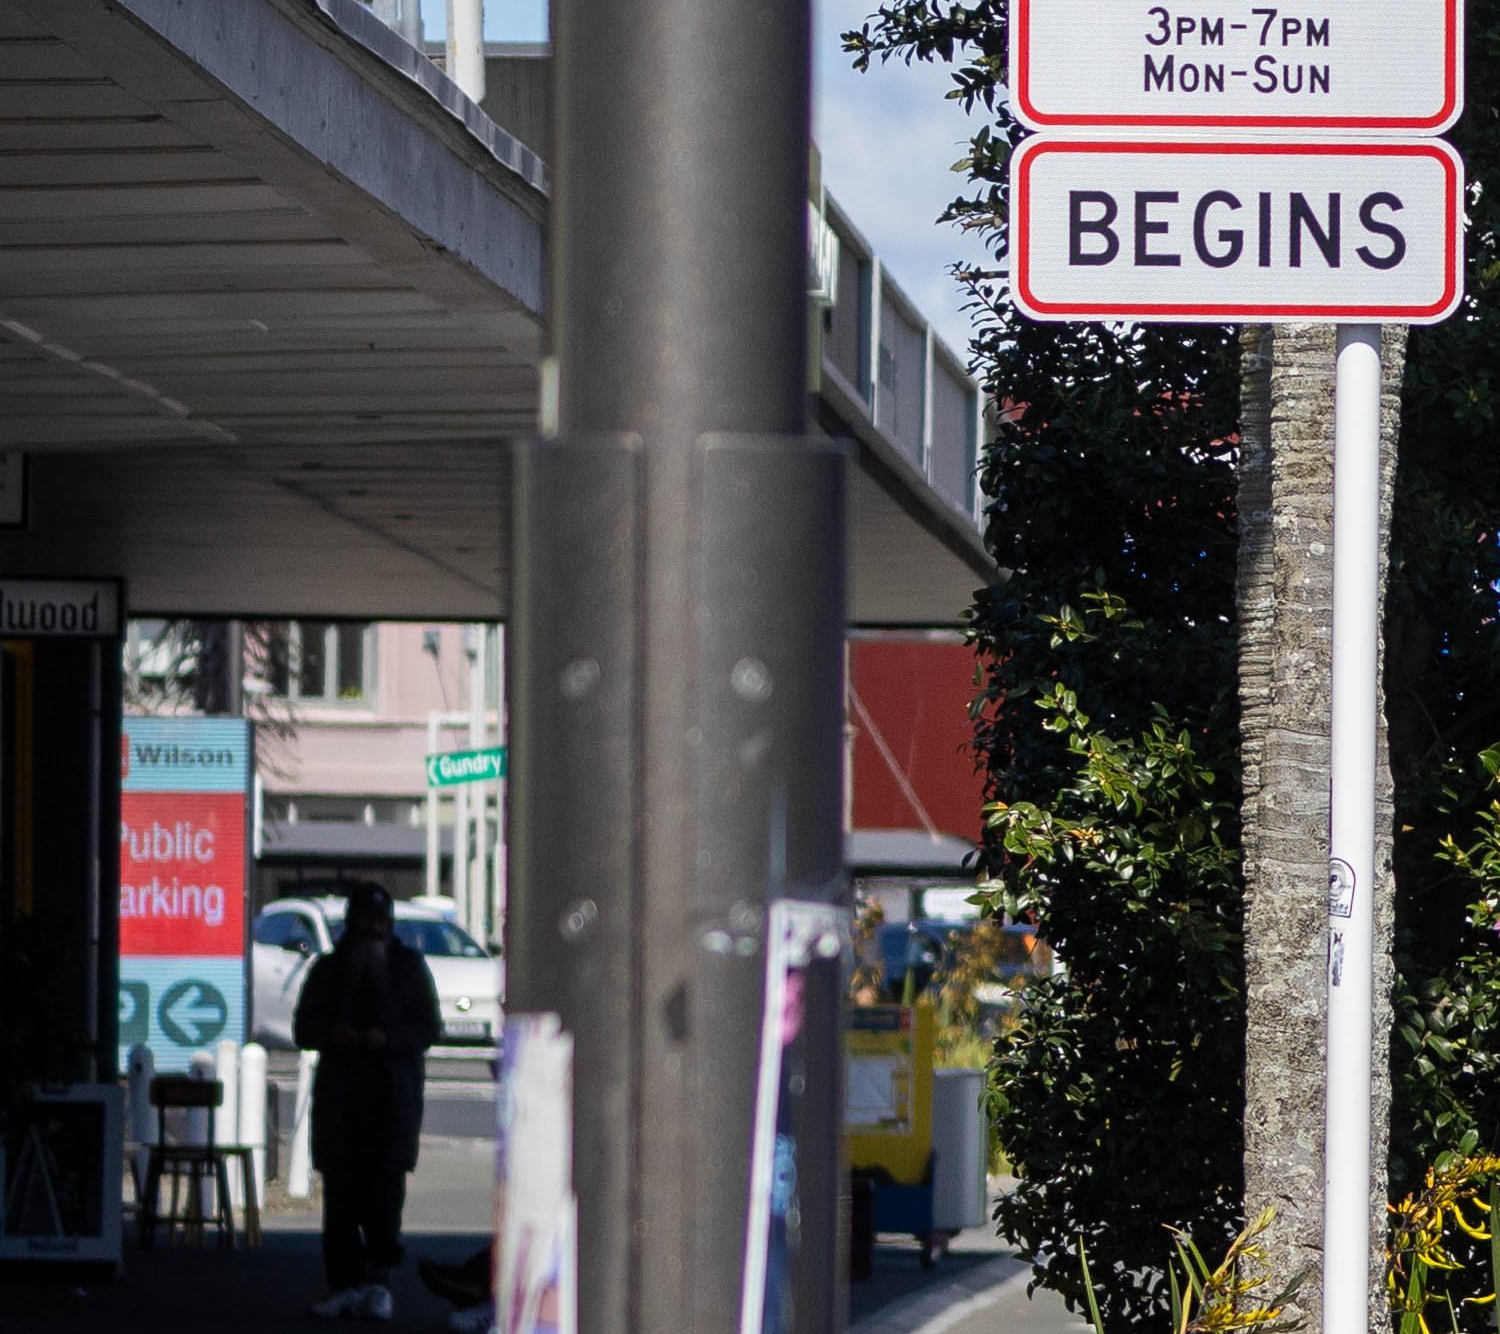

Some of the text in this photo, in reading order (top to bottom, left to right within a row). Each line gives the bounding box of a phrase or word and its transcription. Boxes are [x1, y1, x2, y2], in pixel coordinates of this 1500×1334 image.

[1069, 190, 1406, 270] BEGINS
[135, 744, 233, 765] Wilson
[440, 753, 502, 778] Gundry
